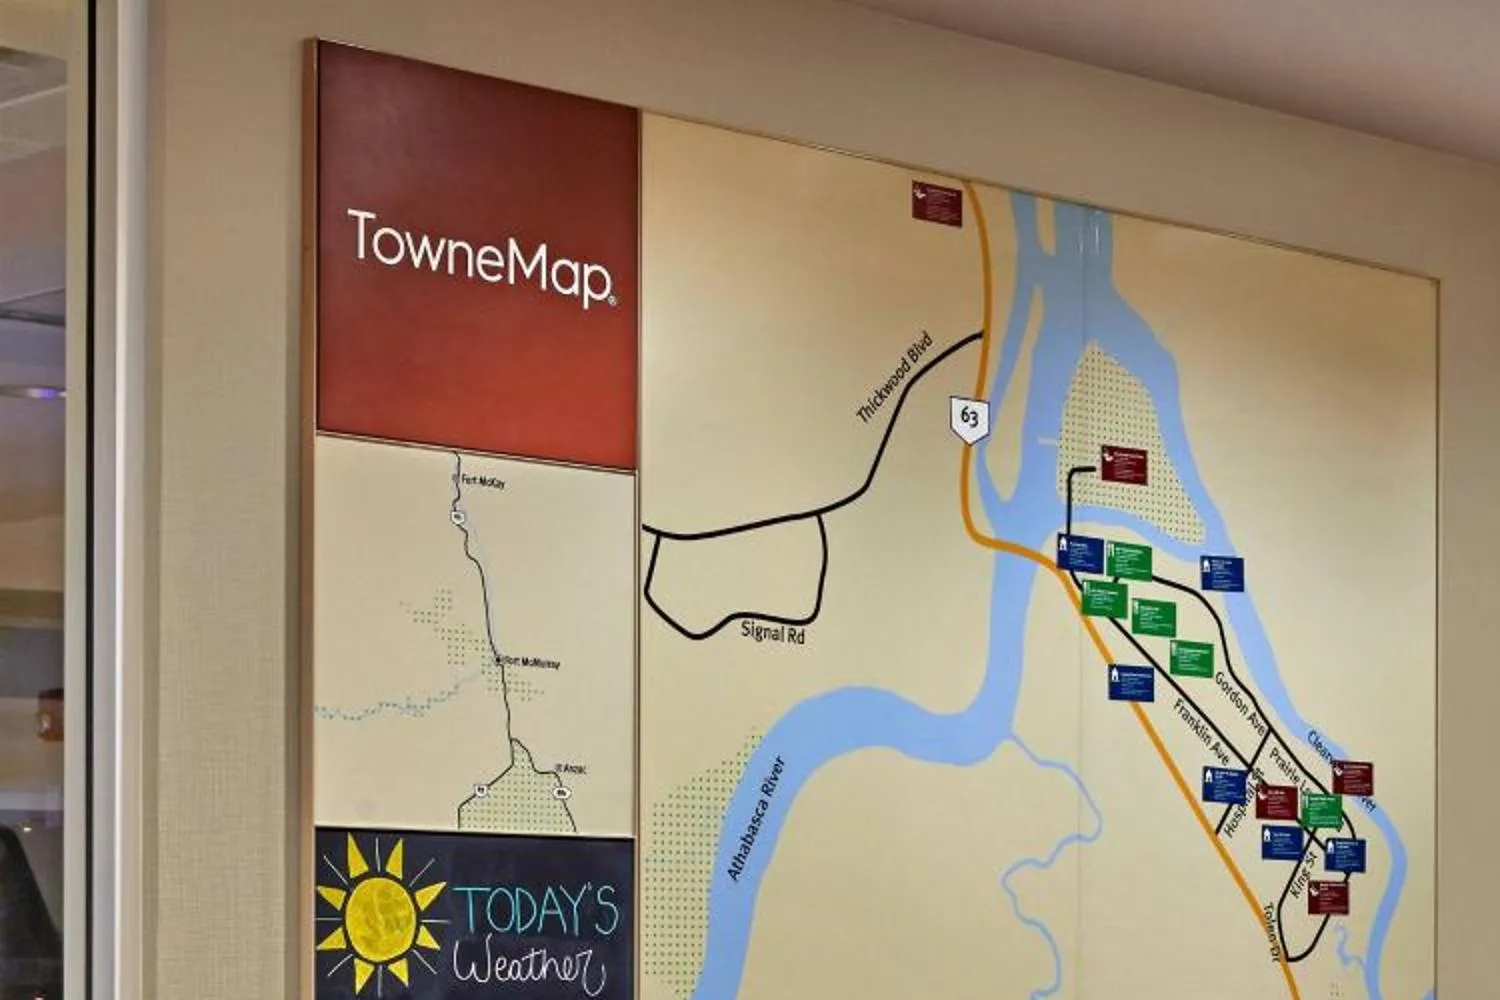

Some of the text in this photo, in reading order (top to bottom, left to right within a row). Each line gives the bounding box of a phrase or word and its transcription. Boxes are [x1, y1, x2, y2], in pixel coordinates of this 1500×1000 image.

[856, 330, 934, 425] Thickwood Blvd
[960, 405, 979, 428] 63
[741, 620, 805, 645] Signal Rd
[1173, 698, 1212, 747] Franklin
[1209, 741, 1230, 766] Ave
[1215, 671, 1265, 737] Gordon Ave
[1269, 747, 1301, 785] Prairie
[727, 754, 786, 883] Athabasca River
[452, 881, 619, 936] TODAY'S
[1289, 866, 1311, 899] King
[453, 932, 607, 997] Weather
